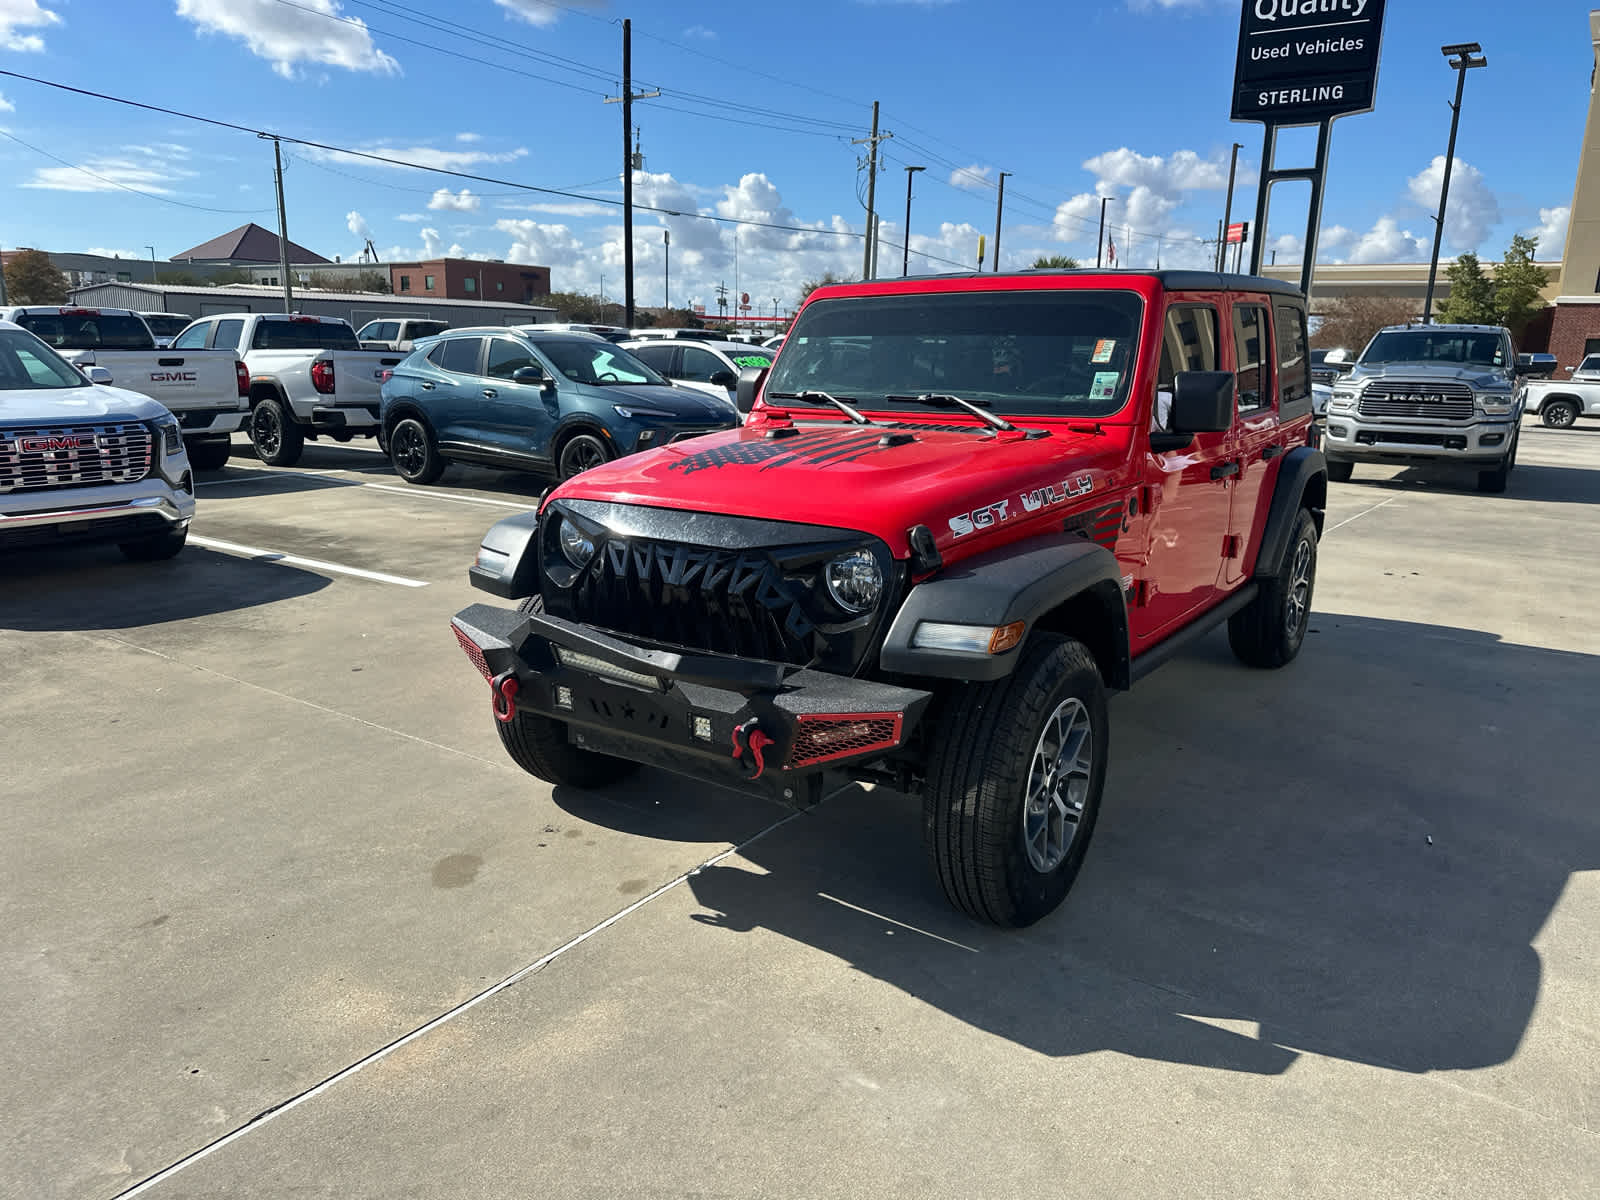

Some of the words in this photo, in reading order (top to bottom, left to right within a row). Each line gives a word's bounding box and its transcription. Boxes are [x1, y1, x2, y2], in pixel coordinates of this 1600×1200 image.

[1251, 42, 1290, 60] Used
[1295, 37, 1364, 55] Vehicles
[1258, 85, 1344, 106] STERLING
[150, 372, 197, 382] GMC
[23, 436, 96, 452] GMC
[948, 499, 1017, 539] SGT.
[1020, 474, 1094, 512] WILLY
